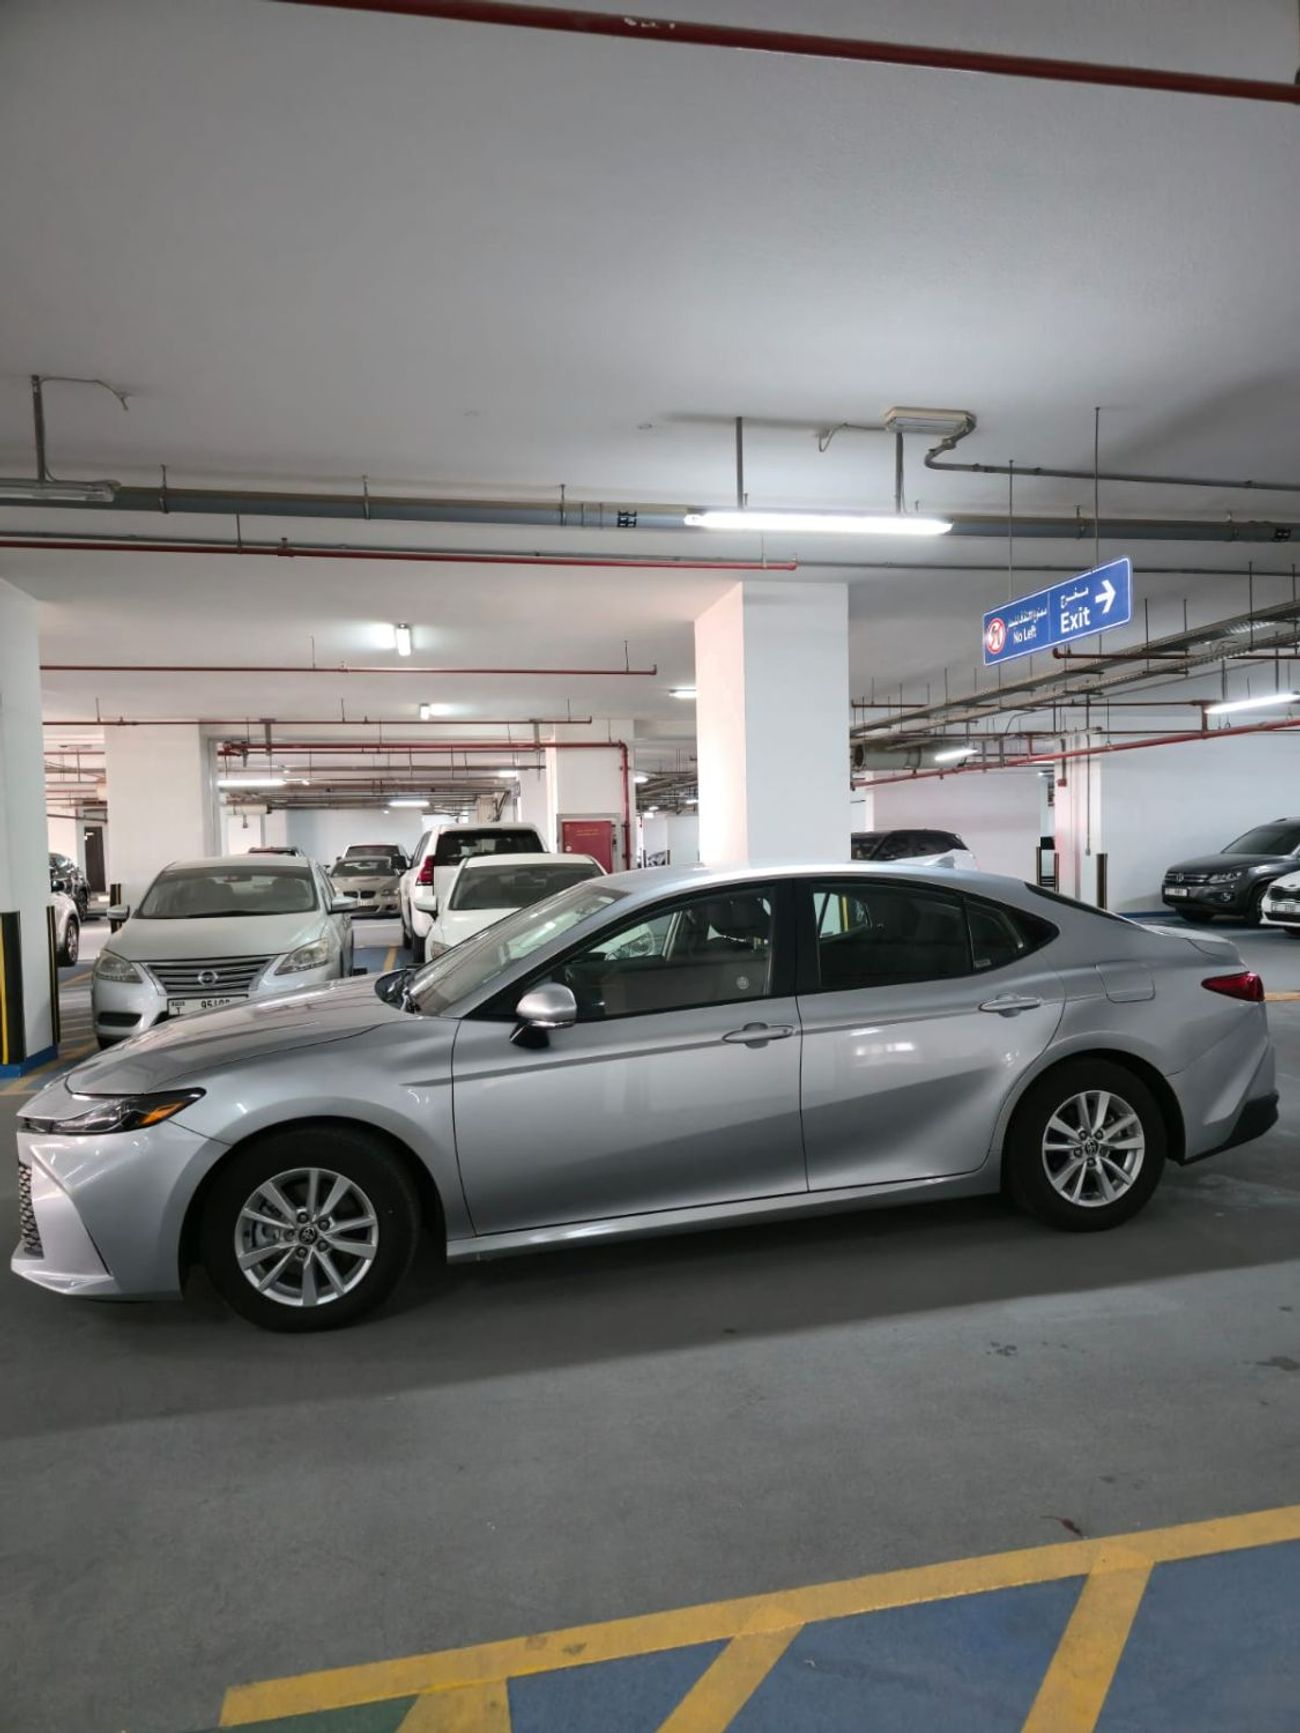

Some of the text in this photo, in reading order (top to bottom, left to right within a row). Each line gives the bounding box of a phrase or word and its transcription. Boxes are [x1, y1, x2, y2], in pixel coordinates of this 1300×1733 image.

[1061, 607, 1091, 634] Exit
[1013, 625, 1037, 643] No Left
